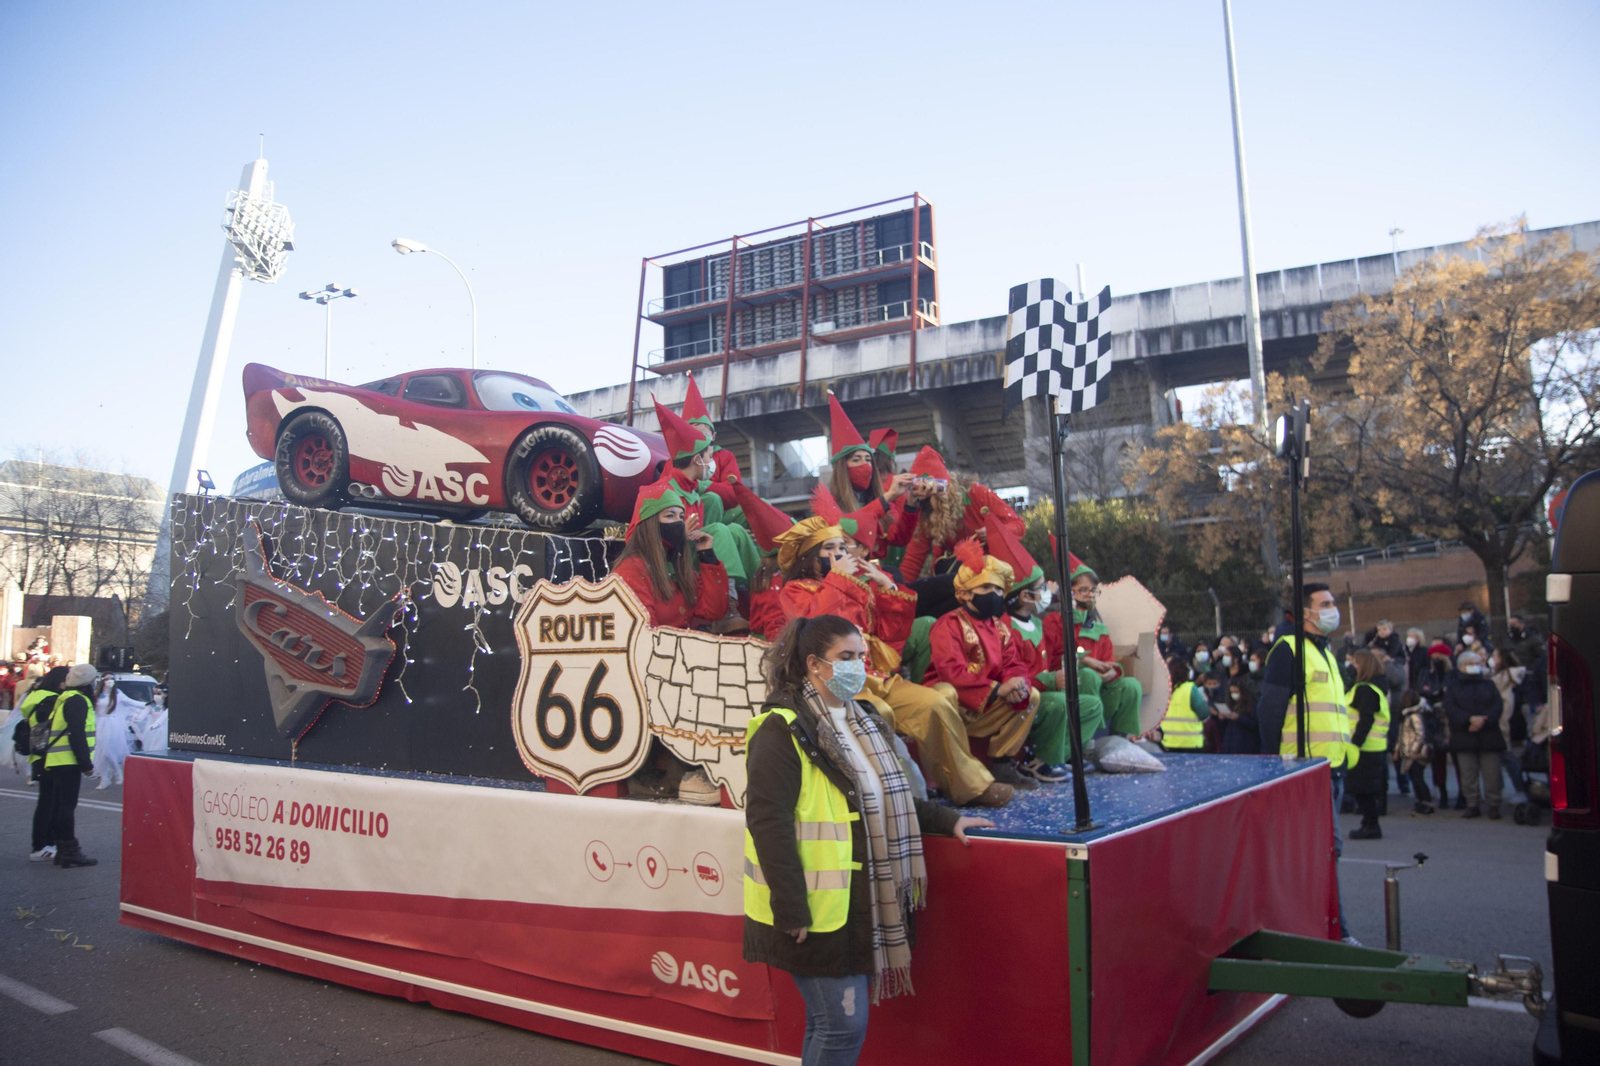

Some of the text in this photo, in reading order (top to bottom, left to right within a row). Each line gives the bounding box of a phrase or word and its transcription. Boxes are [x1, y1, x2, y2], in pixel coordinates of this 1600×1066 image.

[517, 426, 588, 459] LIGHTYEAR
[236, 465, 276, 491] naturalme
[416, 470, 490, 505] ASC
[512, 491, 581, 528] LIGHTYEAR
[462, 564, 534, 606] ASC
[243, 598, 351, 686] Cars
[539, 612, 615, 642] ROUTE
[536, 659, 624, 754] 66
[169, 732, 227, 746] #NosVamosConASC
[202, 787, 389, 838] GASÓLEO A DOMICILIO
[216, 827, 310, 864] 958 52 26 89
[681, 961, 740, 998] ASC
